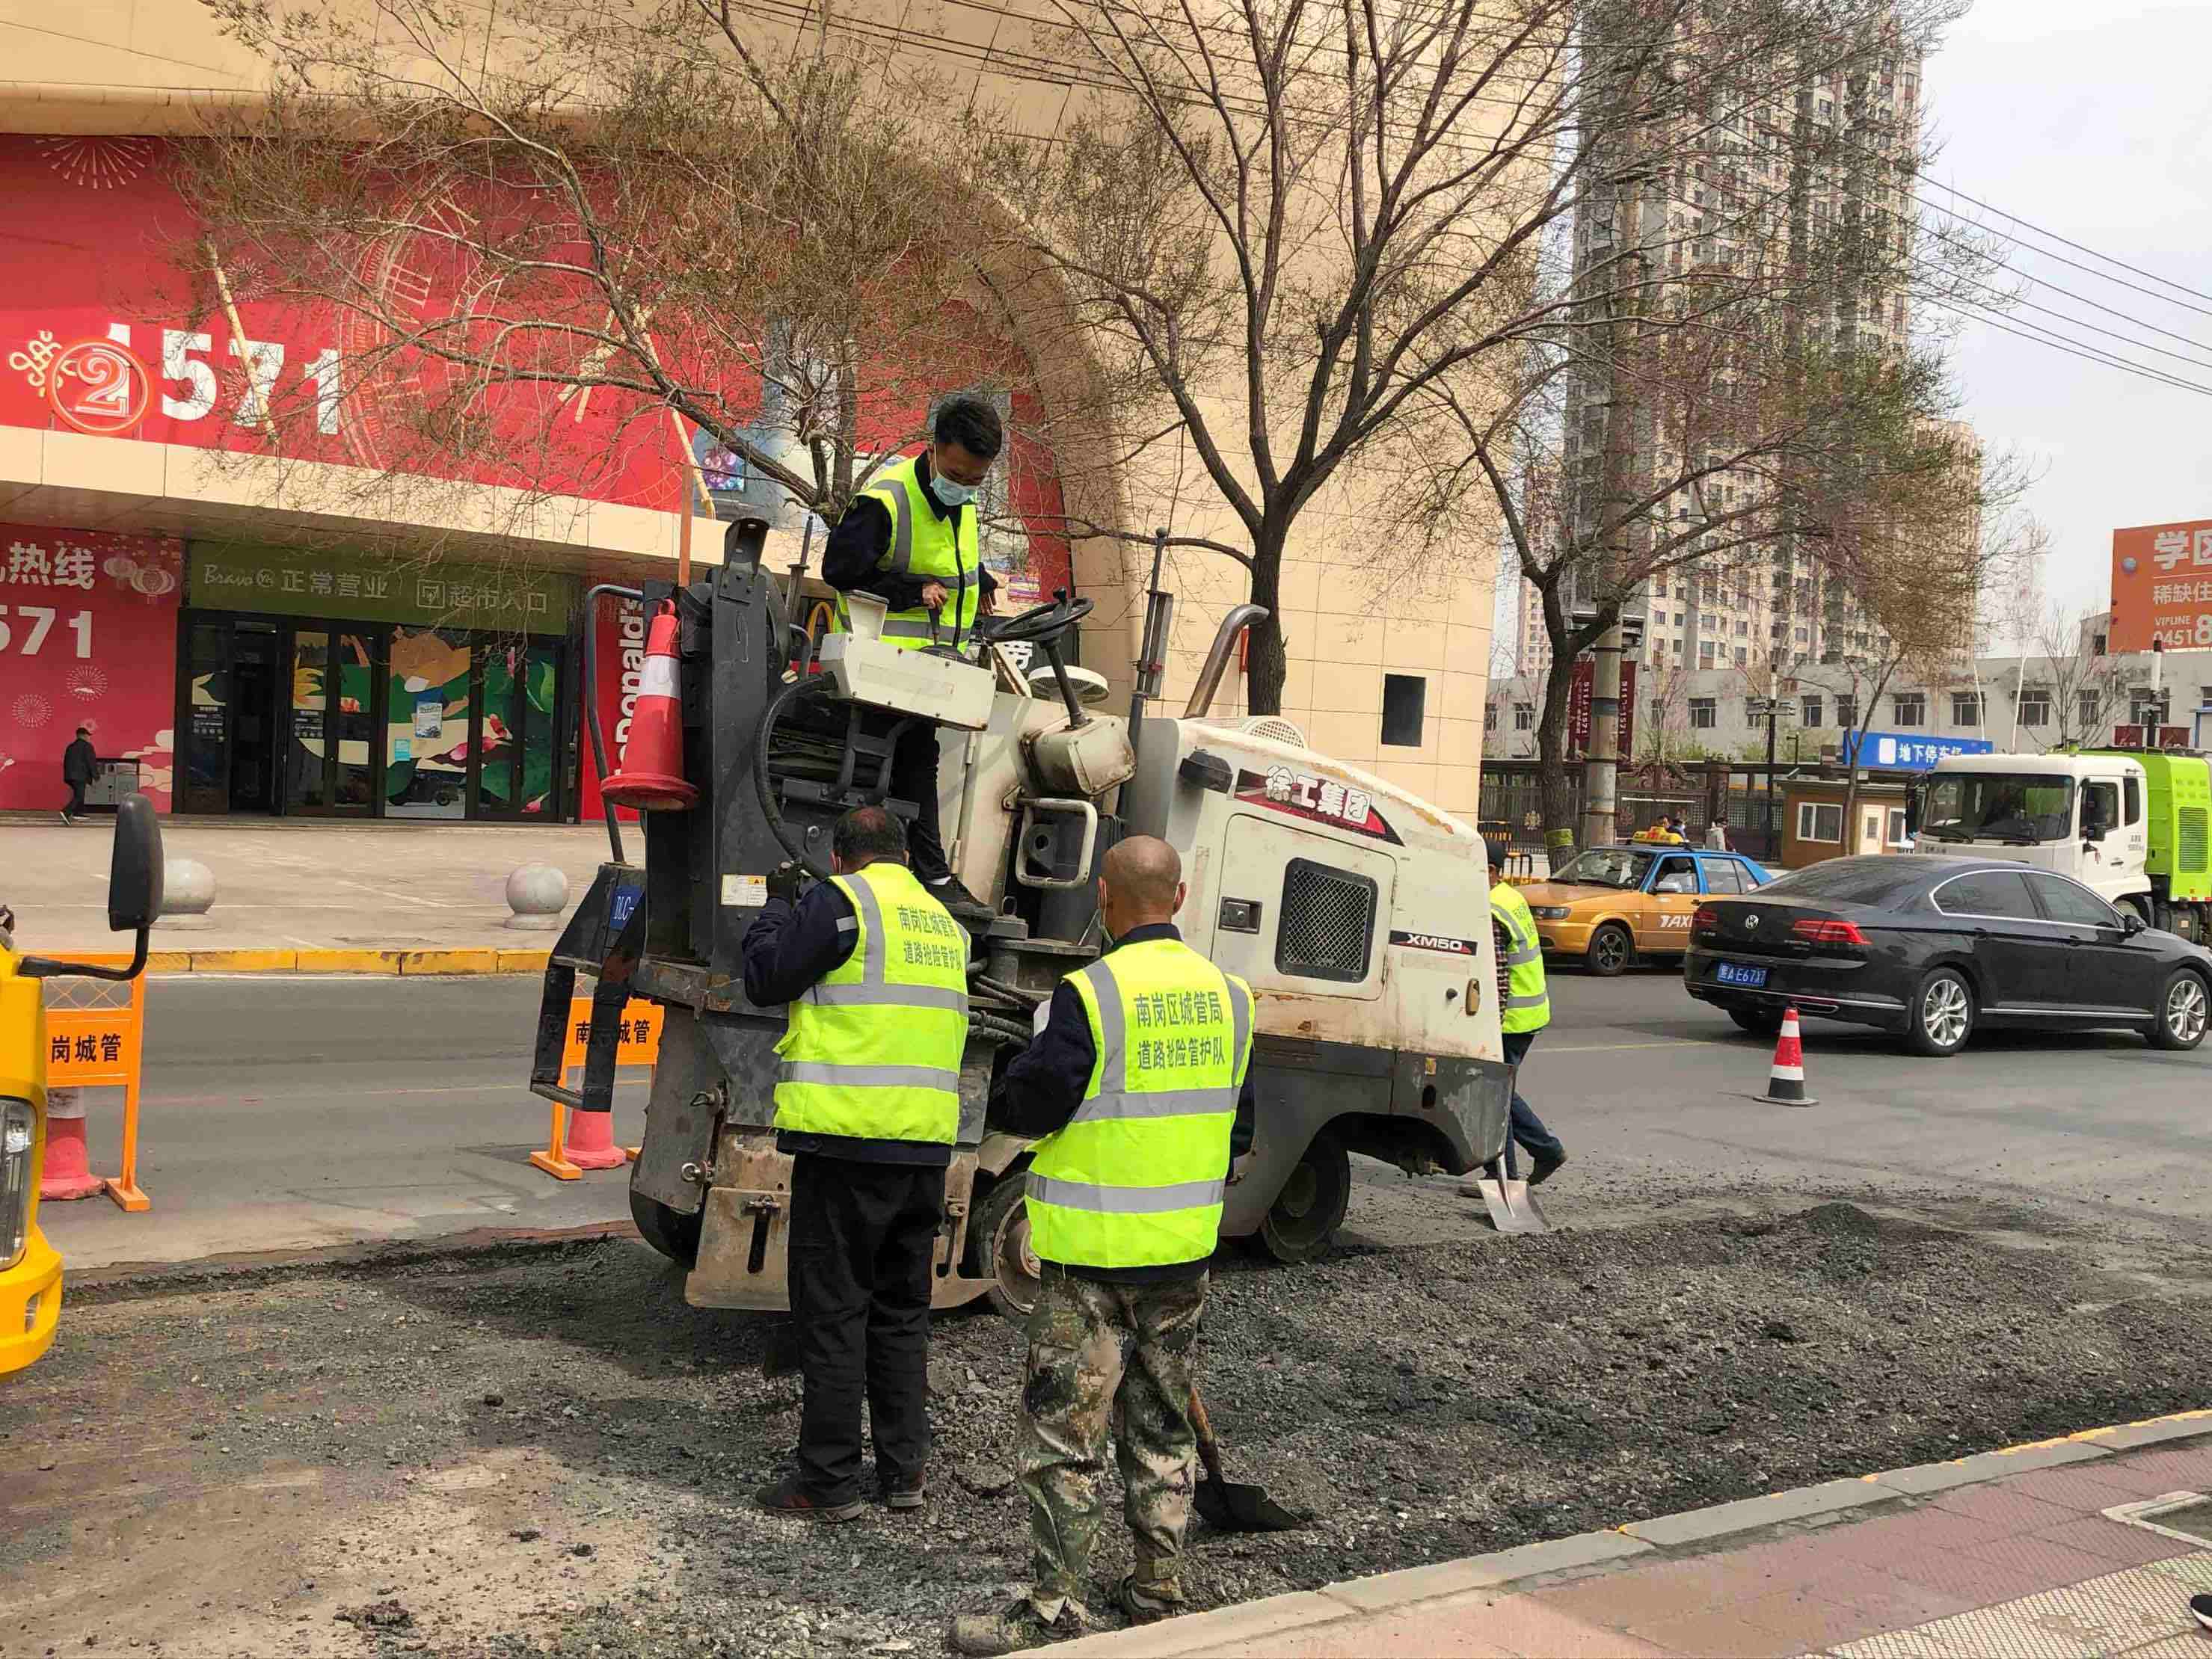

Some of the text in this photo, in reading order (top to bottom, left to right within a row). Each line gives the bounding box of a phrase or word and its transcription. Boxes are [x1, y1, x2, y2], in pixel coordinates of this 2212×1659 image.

[0, 542, 95, 589] 热线
[281, 569, 547, 614] 正常营业 超市入口
[1266, 766, 1373, 825] 徐工集团
[1407, 934, 1463, 952] XM50
[1134, 991, 1223, 1028] 南岗区城管局
[51, 1033, 121, 1063] 岗城管
[575, 1020, 650, 1045] 南城管
[1137, 1036, 1225, 1070] 道路抢险管护队
